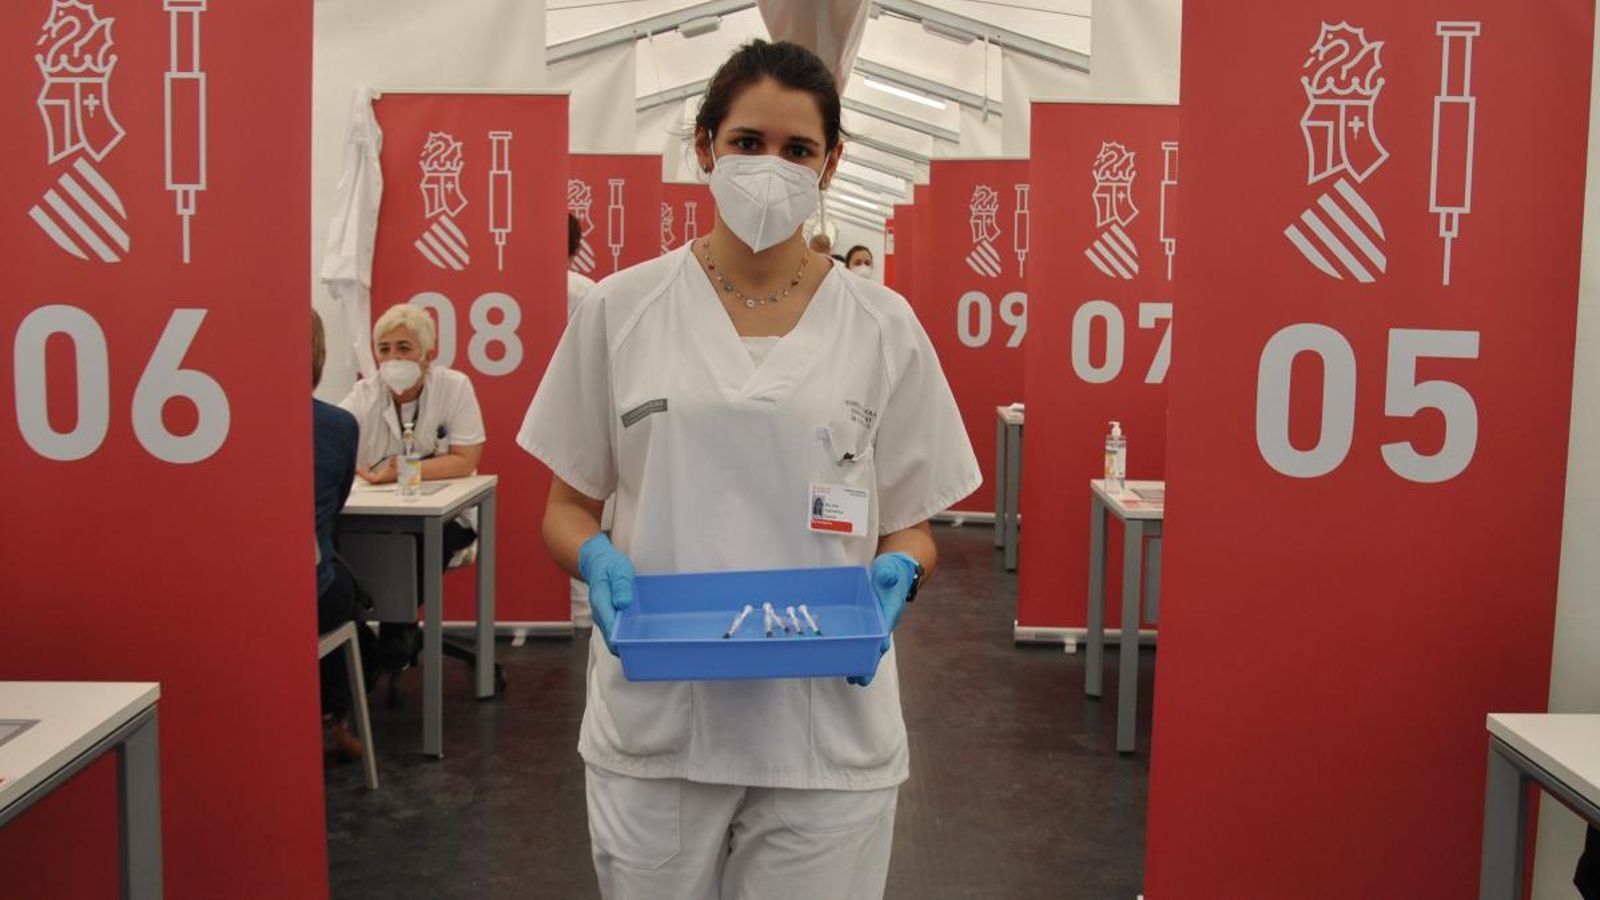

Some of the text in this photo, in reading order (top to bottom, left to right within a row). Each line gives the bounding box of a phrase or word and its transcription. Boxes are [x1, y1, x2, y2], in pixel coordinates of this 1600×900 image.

[957, 291, 1028, 348] 09
[1071, 300, 1173, 384] 07
[14, 304, 230, 464] 06
[1256, 323, 1480, 483] 05
